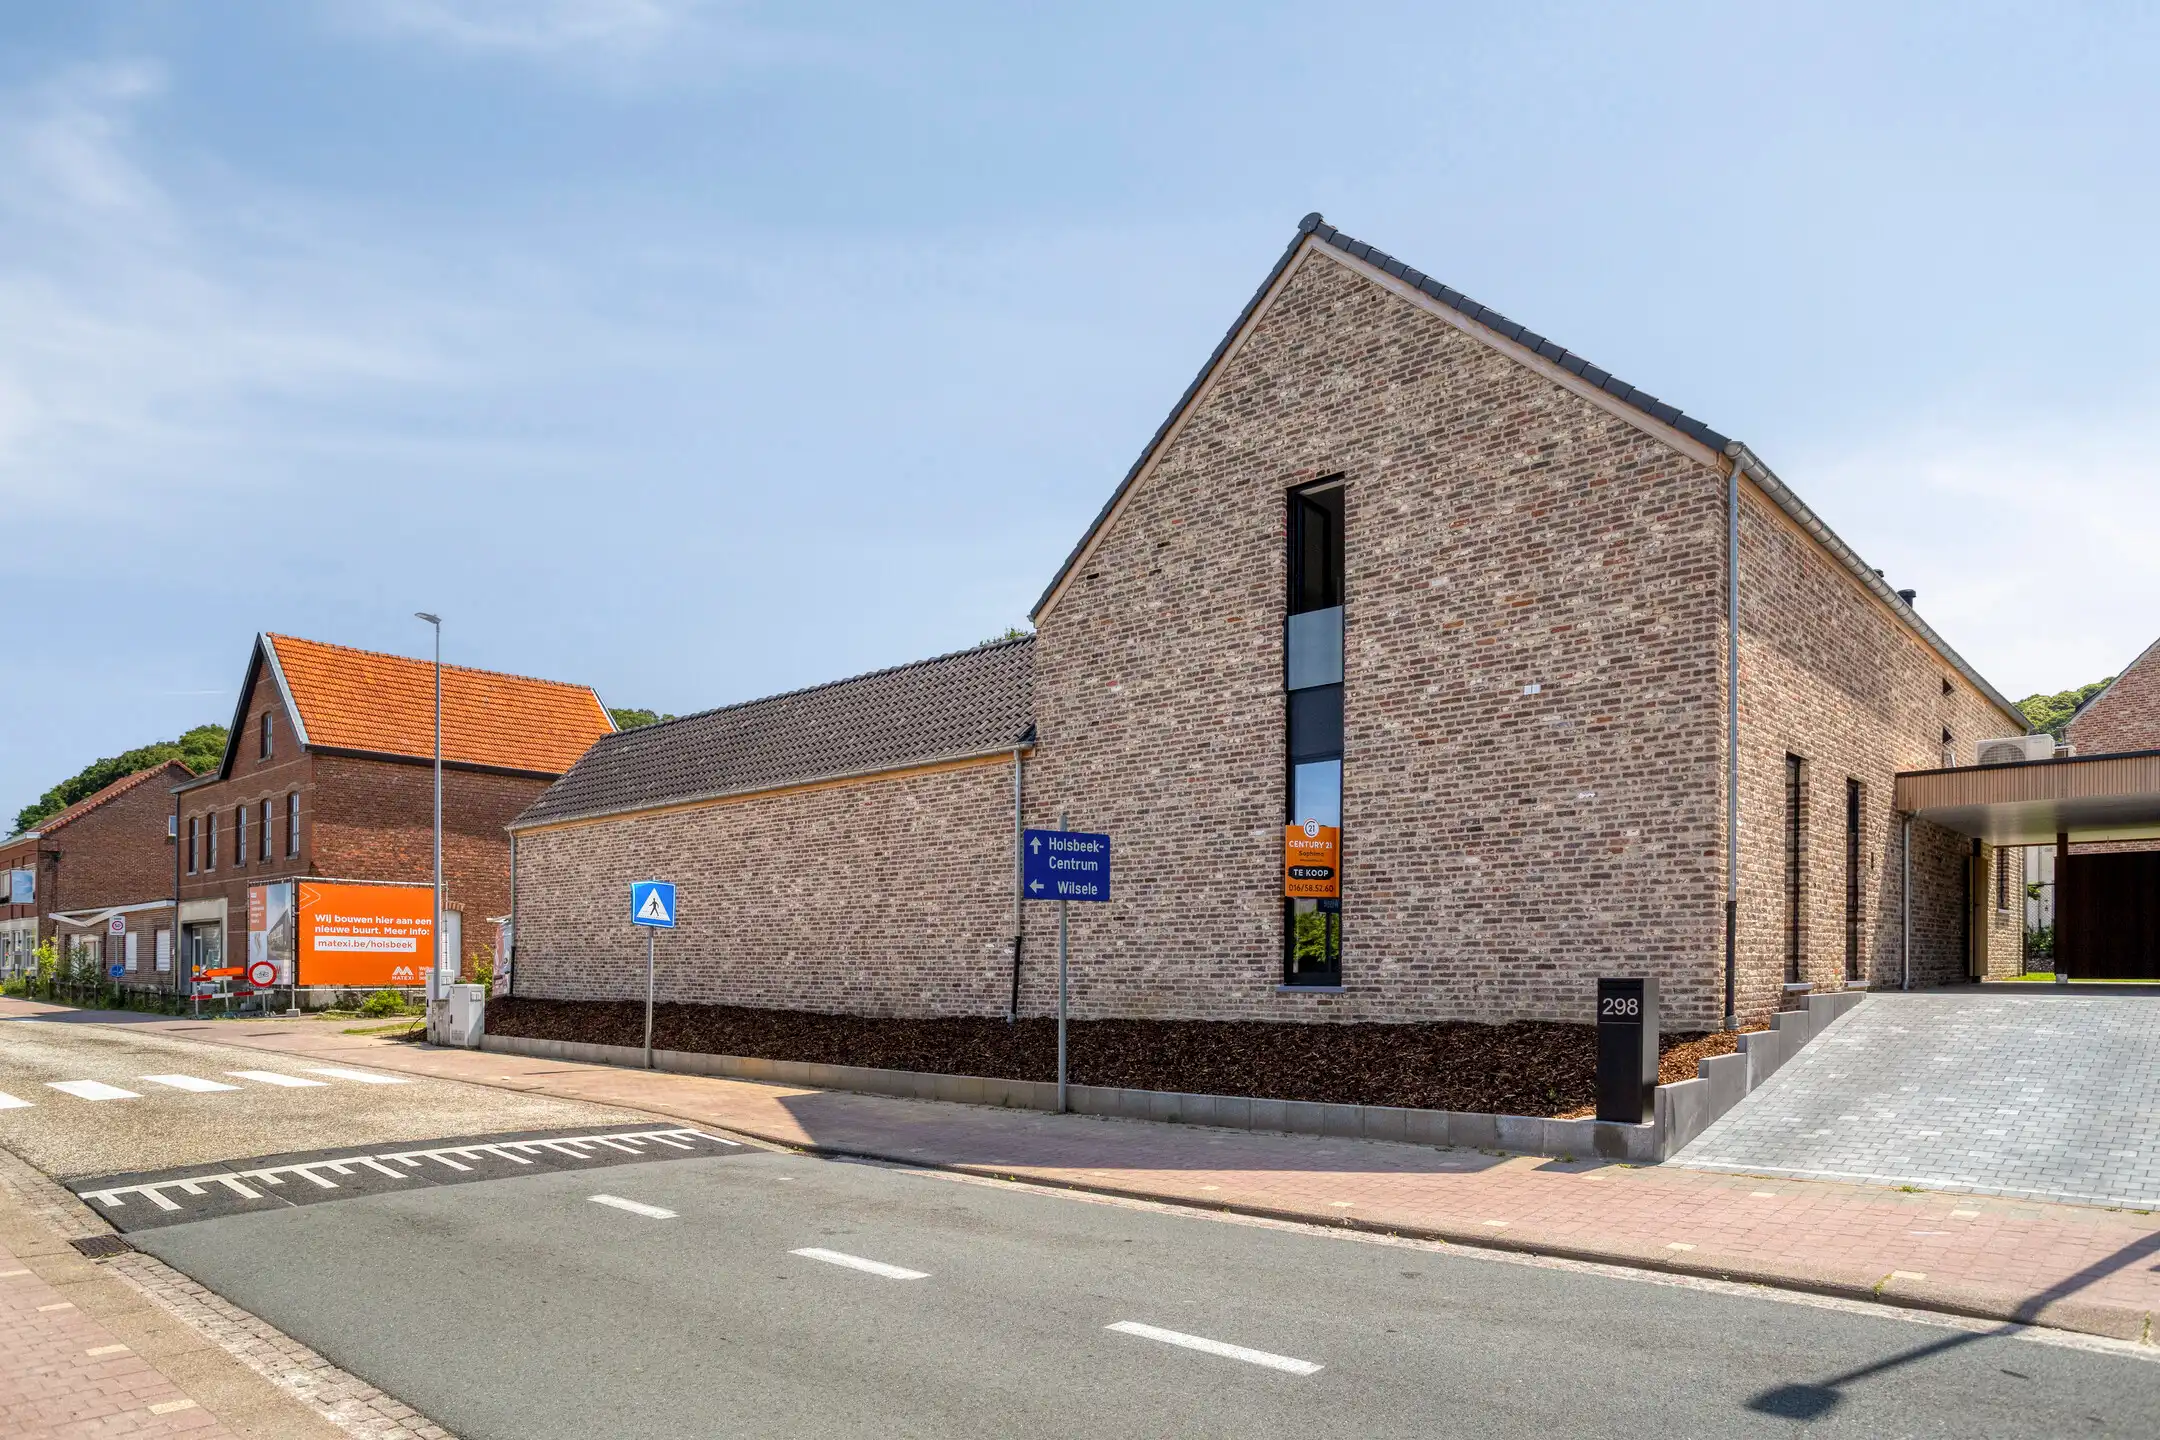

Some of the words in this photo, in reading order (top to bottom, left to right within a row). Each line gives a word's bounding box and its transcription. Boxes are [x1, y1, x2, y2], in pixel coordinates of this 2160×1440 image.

[1049, 837, 1104, 852] Holsbeek-
[1288, 840, 1324, 848] CENTURY
[1048, 855, 1098, 871] Centrum
[1293, 868, 1303, 876] TE
[1305, 869, 1329, 877] KOOP
[1057, 880, 1098, 895] Wilsele
[1288, 883, 1334, 892] 016/58.52.60
[314, 913, 332, 923] Wij
[334, 914, 373, 924] bouwen
[375, 916, 393, 924] hier
[395, 917, 413, 925] aan
[314, 925, 350, 933] nieuwe
[352, 926, 381, 935] buurt.
[383, 927, 407, 935] Meer
[317, 939, 413, 949] matexi.be/holsbeek
[1602, 997, 1639, 1015] 298
